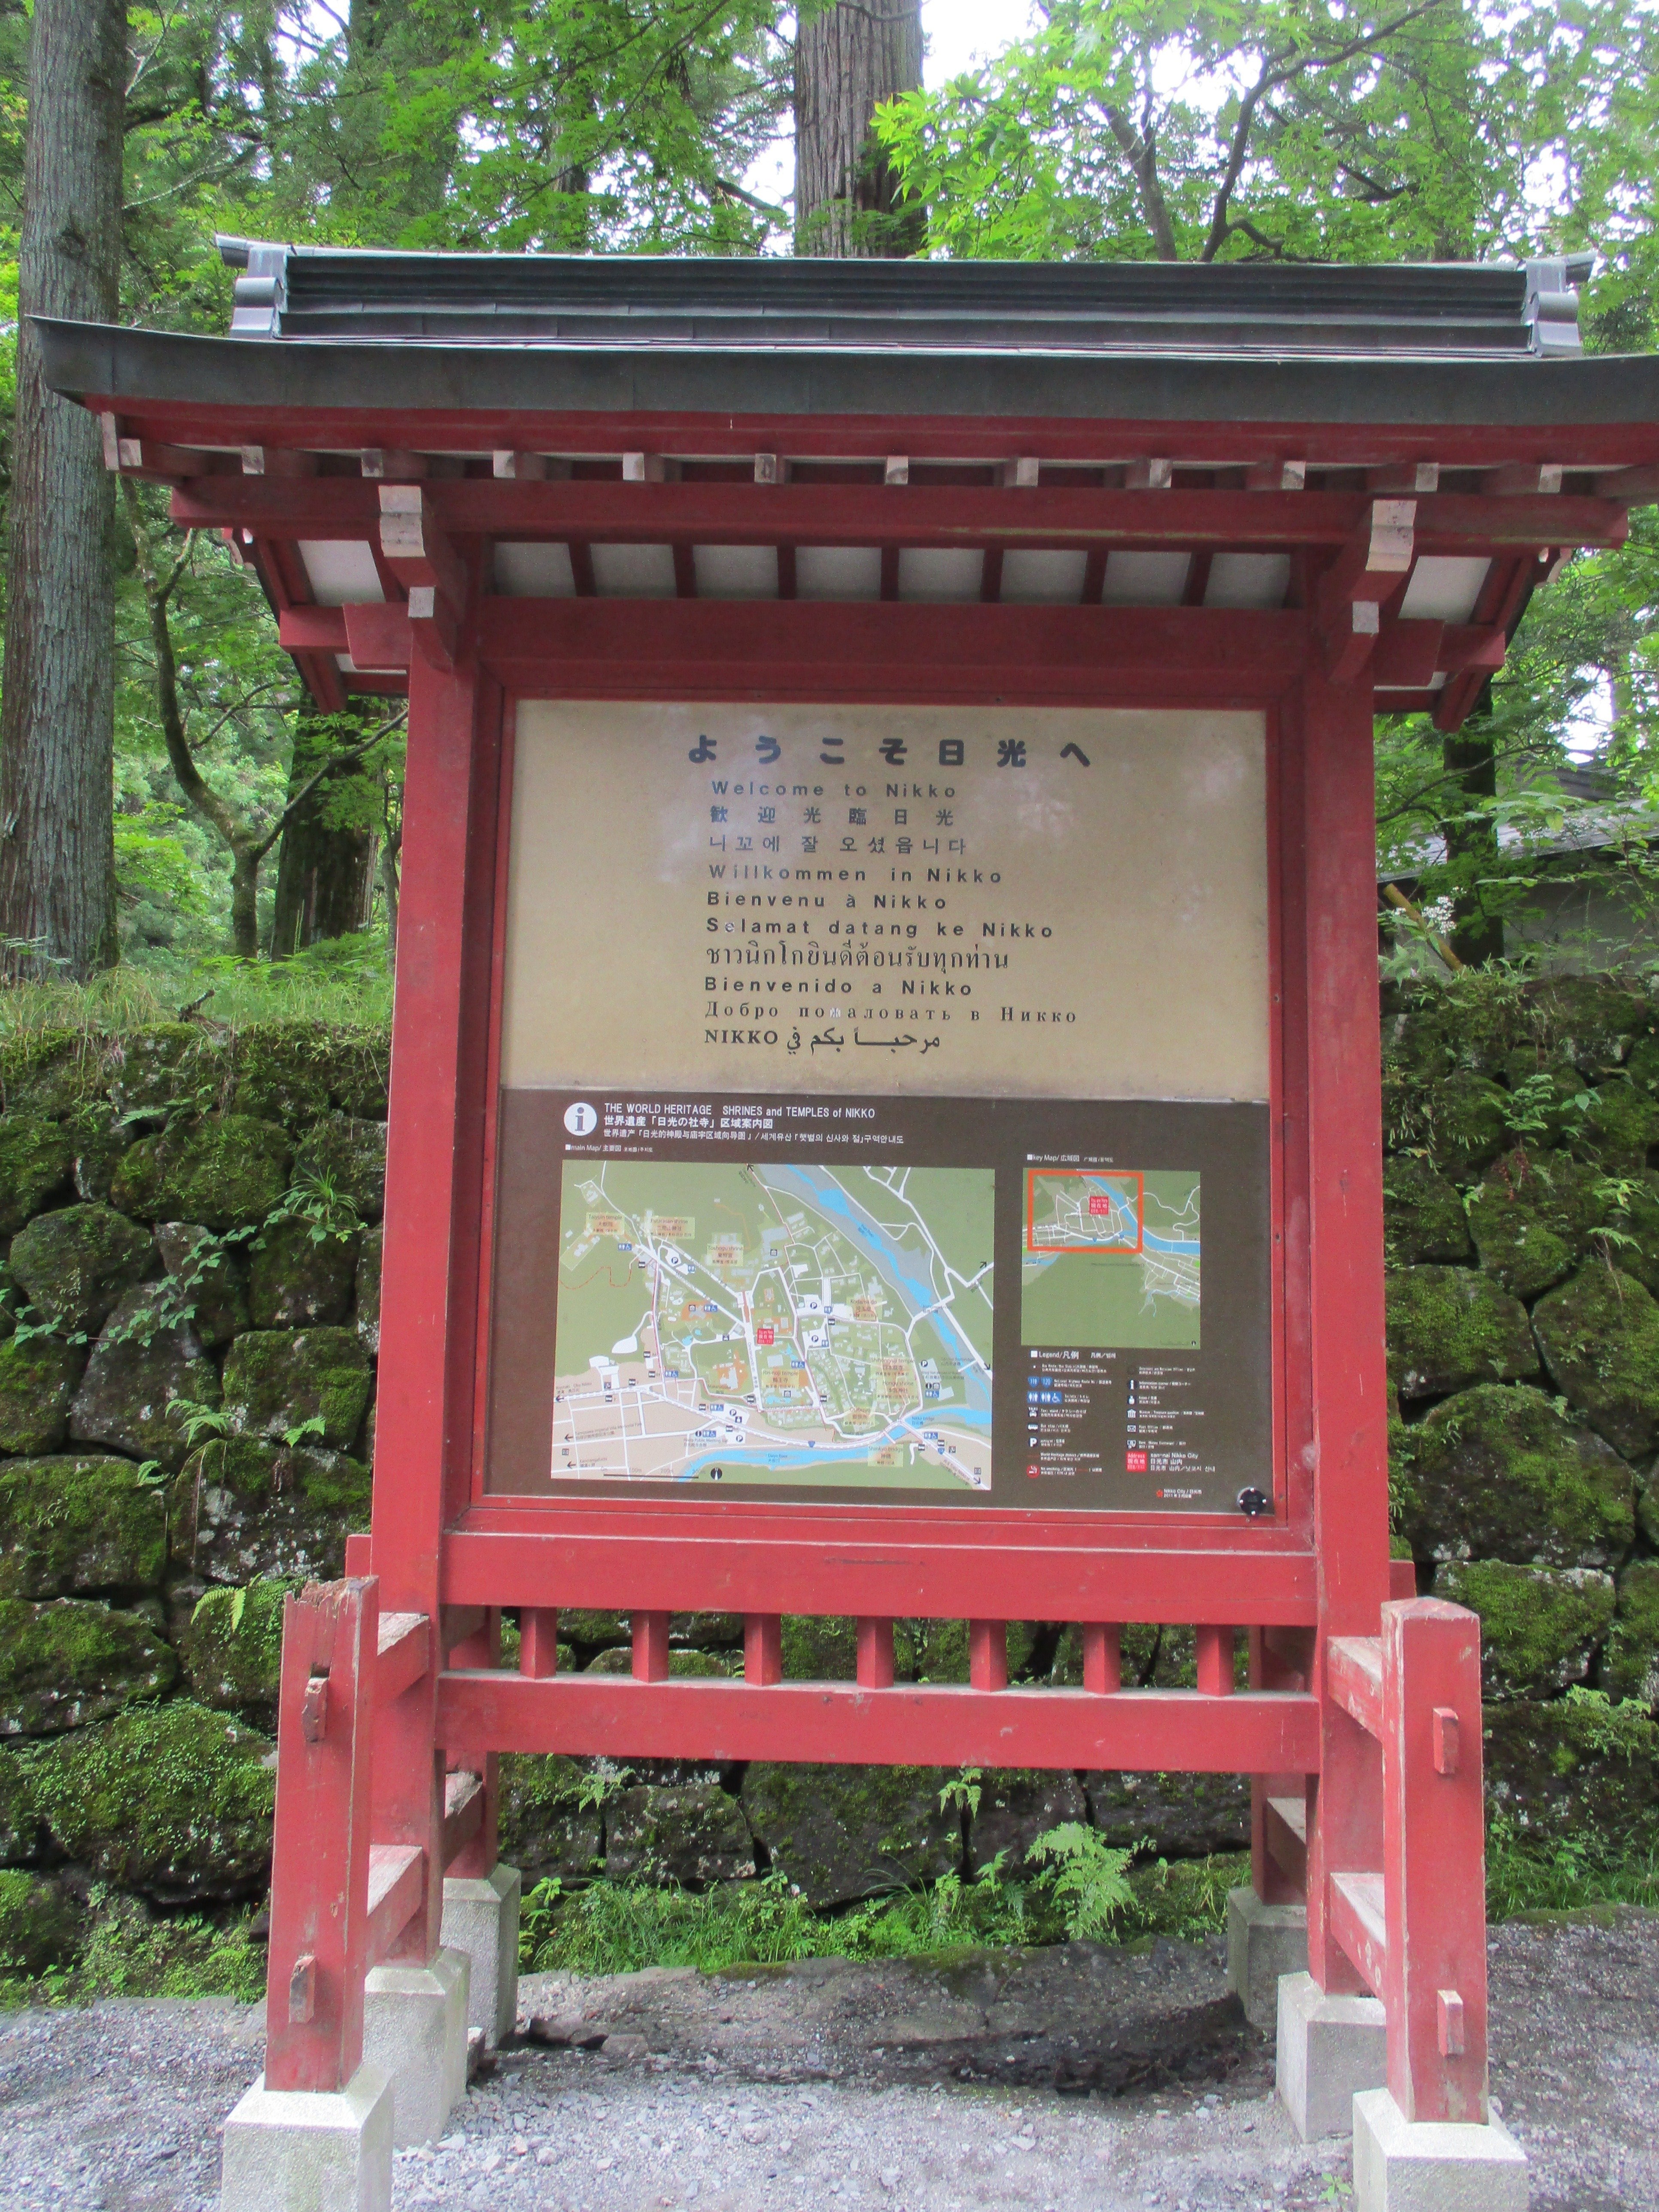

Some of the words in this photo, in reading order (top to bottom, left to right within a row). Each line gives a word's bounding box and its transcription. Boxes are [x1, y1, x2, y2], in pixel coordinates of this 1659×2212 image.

[688, 735, 1091, 768] ようこそ日光へ
[712, 781, 823, 796] Welcome
[845, 784, 866, 796] to
[886, 783, 955, 798] Nikko
[802, 836, 819, 854] 잘
[709, 864, 866, 881] Willkommen
[891, 867, 912, 882] in
[927, 868, 1001, 884] Nikko
[707, 891, 824, 907] Bienvenu
[846, 893, 856, 908] à
[874, 894, 946, 909] Nikko
[706, 917, 809, 934] Selamat
[829, 920, 917, 939] datang
[937, 921, 964, 936] ke
[982, 922, 1052, 938] Nikko
[705, 976, 852, 994] Bienvenido
[872, 983, 882, 994] a
[902, 980, 971, 996] Nikko
[705, 1001, 778, 1020] Добро
[799, 1006, 951, 1021] пожаловать
[971, 1010, 980, 1021] в
[1000, 1006, 1076, 1023] Никко
[704, 1029, 778, 1045] NIKKO
[787, 1026, 801, 1055] في
[810, 1027, 845, 1056] بكم
[604, 1103, 622, 1113] THE
[626, 1103, 661, 1114] WORLD
[664, 1104, 711, 1115] HERITAGE
[723, 1105, 763, 1116] SHRINES
[766, 1106, 782, 1116] and
[786, 1106, 829, 1117] TEMPLES
[833, 1107, 842, 1118] of
[845, 1108, 875, 1118] NIKKO
